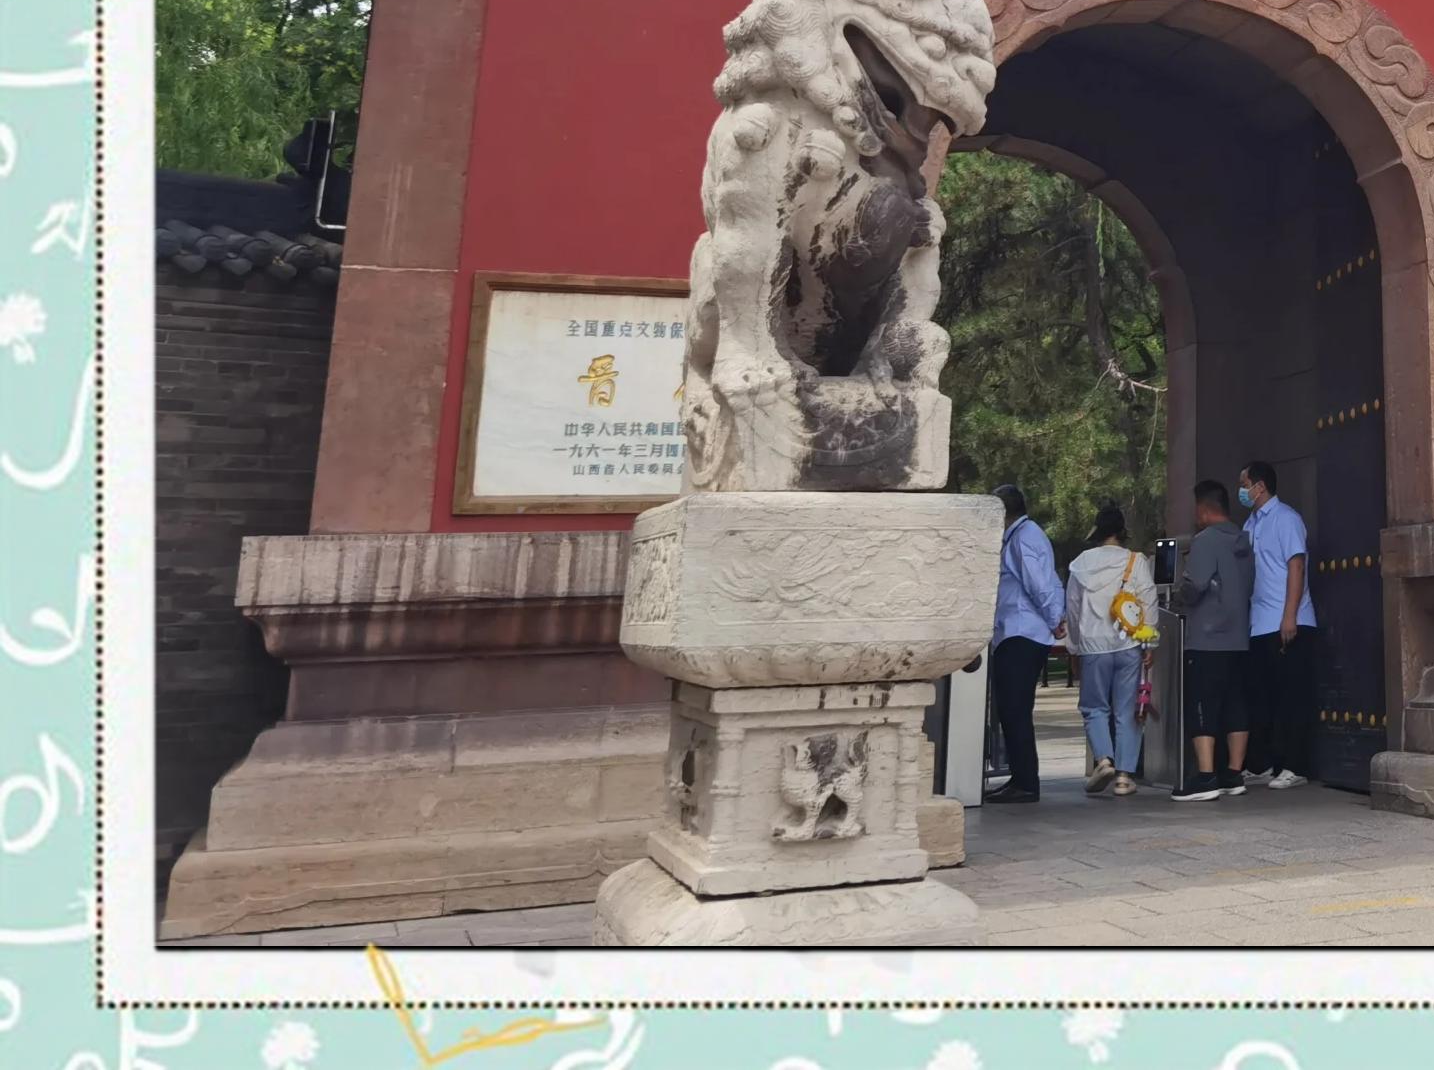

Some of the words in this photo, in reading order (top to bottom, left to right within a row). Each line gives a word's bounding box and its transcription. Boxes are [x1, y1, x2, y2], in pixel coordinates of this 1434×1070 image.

[566, 319, 687, 339] 全国重点文物保
[577, 353, 620, 408] 晋
